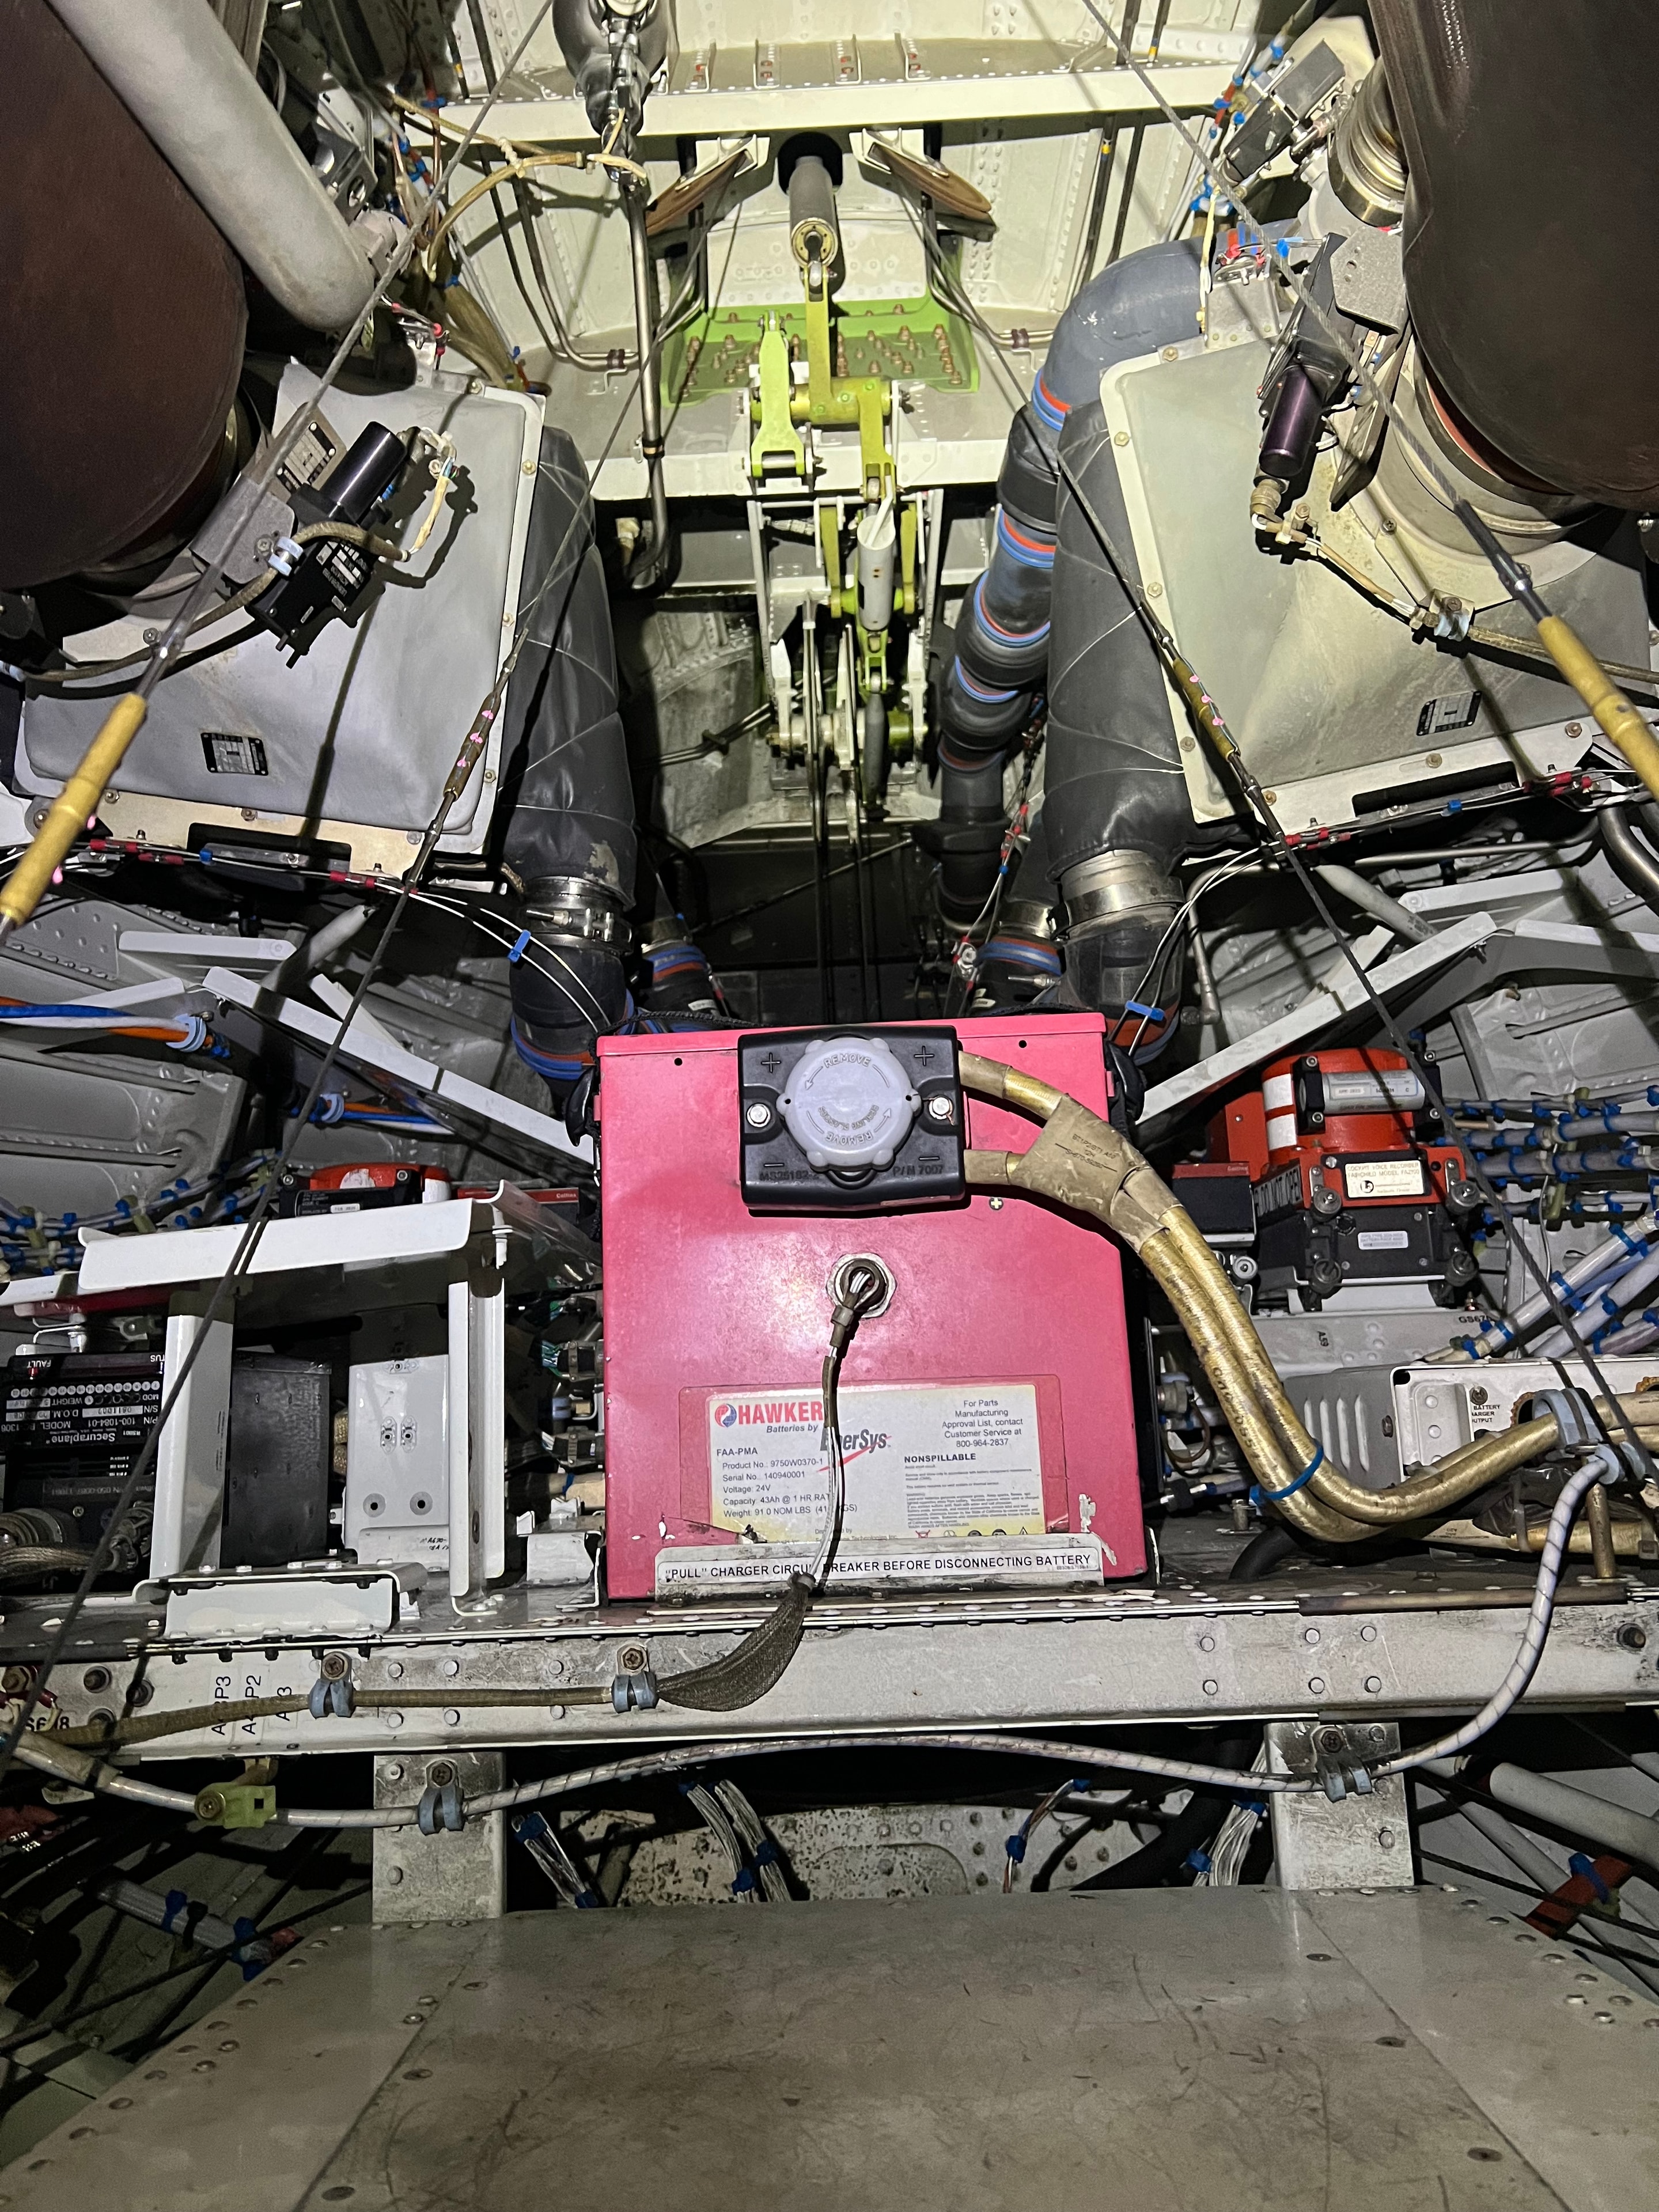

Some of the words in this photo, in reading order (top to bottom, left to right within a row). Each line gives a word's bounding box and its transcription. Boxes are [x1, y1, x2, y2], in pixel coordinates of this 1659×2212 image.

[824, 1053, 872, 1067] REMOVE
[825, 1131, 874, 1146] REMOVE
[150, 1354, 165, 1362] TUS
[27, 1359, 51, 1368] FAULT
[52, 1397, 82, 1406] WEIGHT
[964, 1400, 976, 1408] For
[143, 1404, 158, 1413] S/N
[738, 1401, 824, 1425] HAWKER
[955, 1408, 1008, 1418] Manufacturing
[88, 1417, 136, 1427] 100-1084-01
[143, 1415, 158, 1425] P/N
[942, 1420, 975, 1429] Approval
[978, 1419, 993, 1427] List,
[40, 1421, 71, 1430] MODEL
[766, 1425, 805, 1433] Batteries
[808, 1423, 819, 1433] by
[51, 1433, 115, 1444] Securaplane
[944, 1430, 981, 1438] Customer
[983, 1429, 1012, 1437] Service
[820, 1429, 887, 1454] erSys
[956, 1438, 1009, 1448] 800-964-2837
[717, 1448, 758, 1456] FAA-PMA
[771, 1459, 823, 1467] 9750W0370-1
[904, 1453, 976, 1463] NONSPILLABLE
[722, 1474, 744, 1482] Serial
[764, 1471, 805, 1479] 140940001
[760, 1495, 780, 1503] 43Ah
[782, 1495, 791, 1504] @
[815, 1493, 830, 1501] RAT
[774, 1506, 793, 1515] NOM
[795, 1506, 811, 1514] LBS
[842, 1504, 857, 1513] GS)
[665, 1568, 707, 1579] "PULL"
[710, 1565, 769, 1577] CHARGER
[772, 1563, 809, 1574] CIRCU
[883, 1560, 931, 1571] BEFORE
[935, 1556, 1032, 1569] DISCONNECTING
[1036, 1554, 1091, 1565] BATTERY
[211, 1676, 231, 1736] AP3
[241, 1675, 261, 1735] AP2
[275, 1686, 292, 1722] A3
